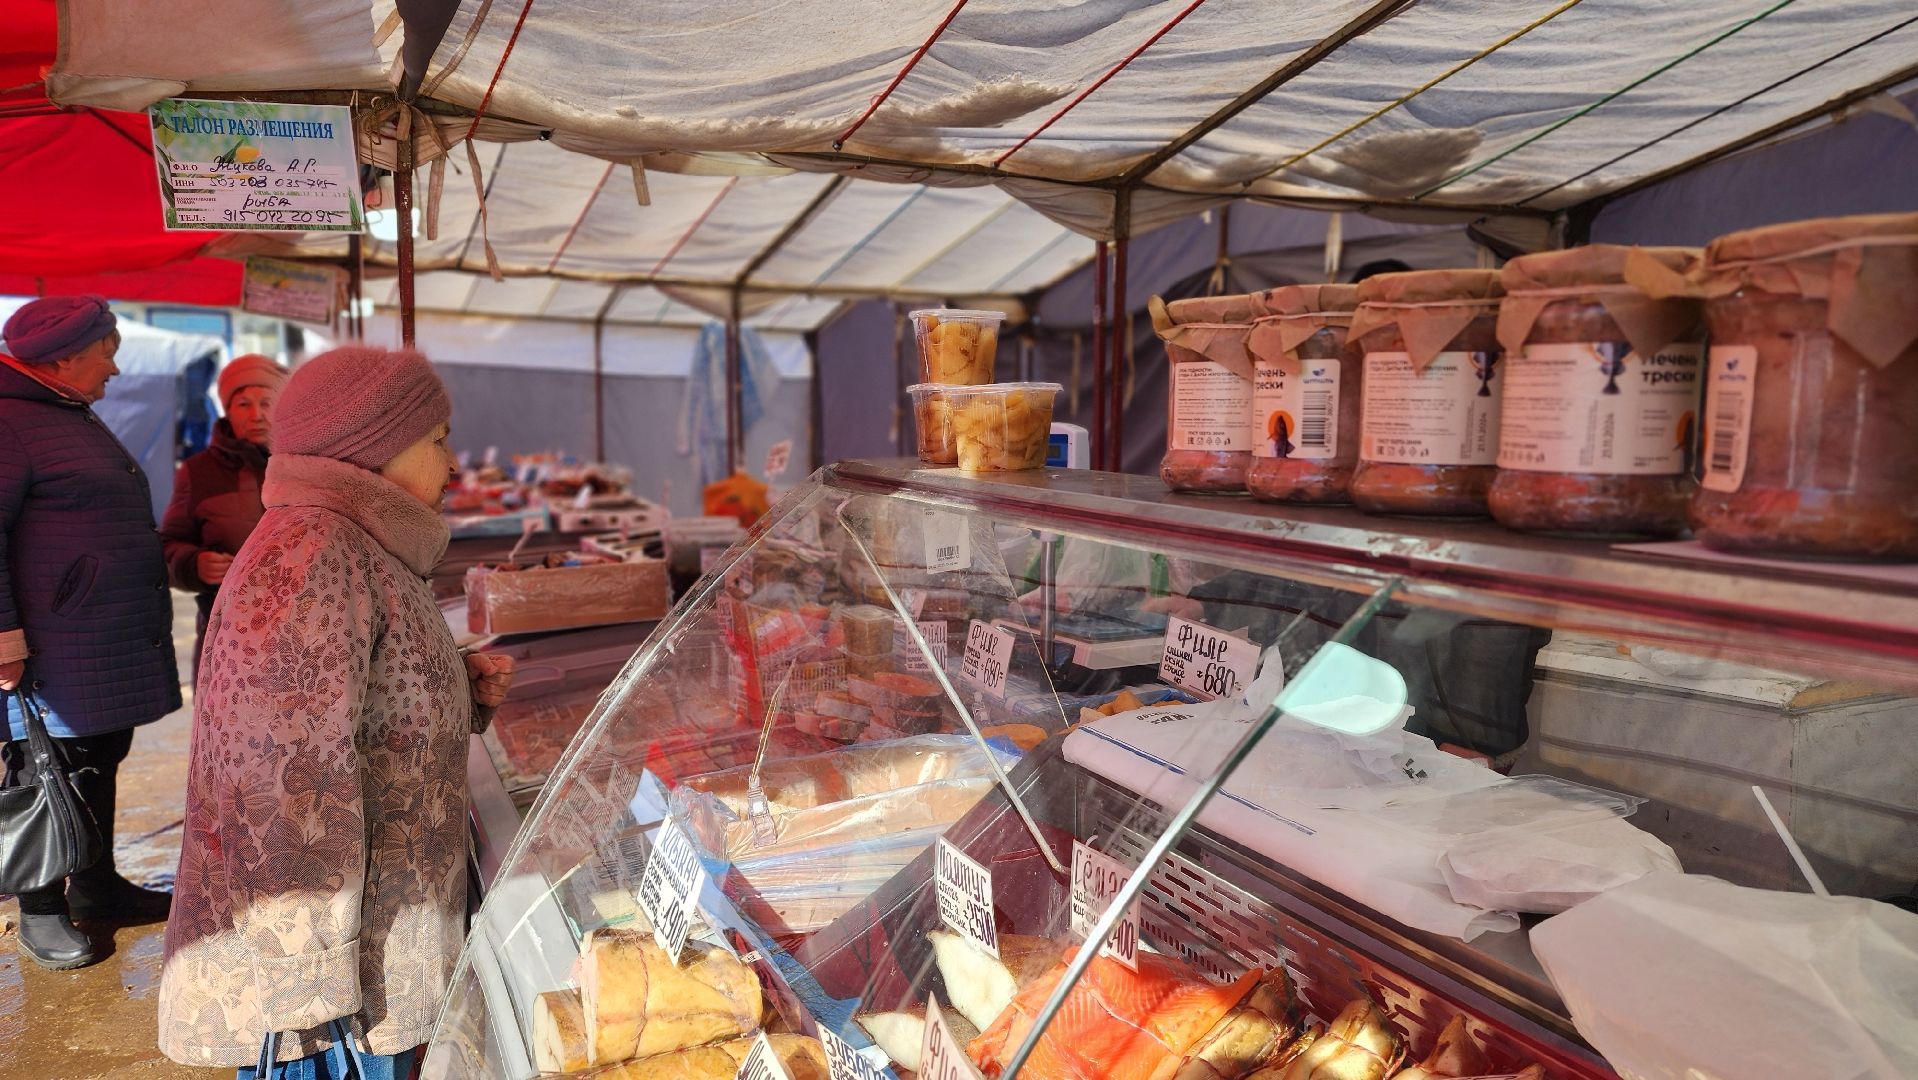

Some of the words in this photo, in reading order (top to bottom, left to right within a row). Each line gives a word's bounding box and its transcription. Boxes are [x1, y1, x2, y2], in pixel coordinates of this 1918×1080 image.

[171, 116, 224, 135] ТАЛОН
[228, 118, 334, 141] РАЗМЕЩЕНИЯ
[1254, 366, 1287, 378] ечень
[1254, 381, 1284, 393] рески
